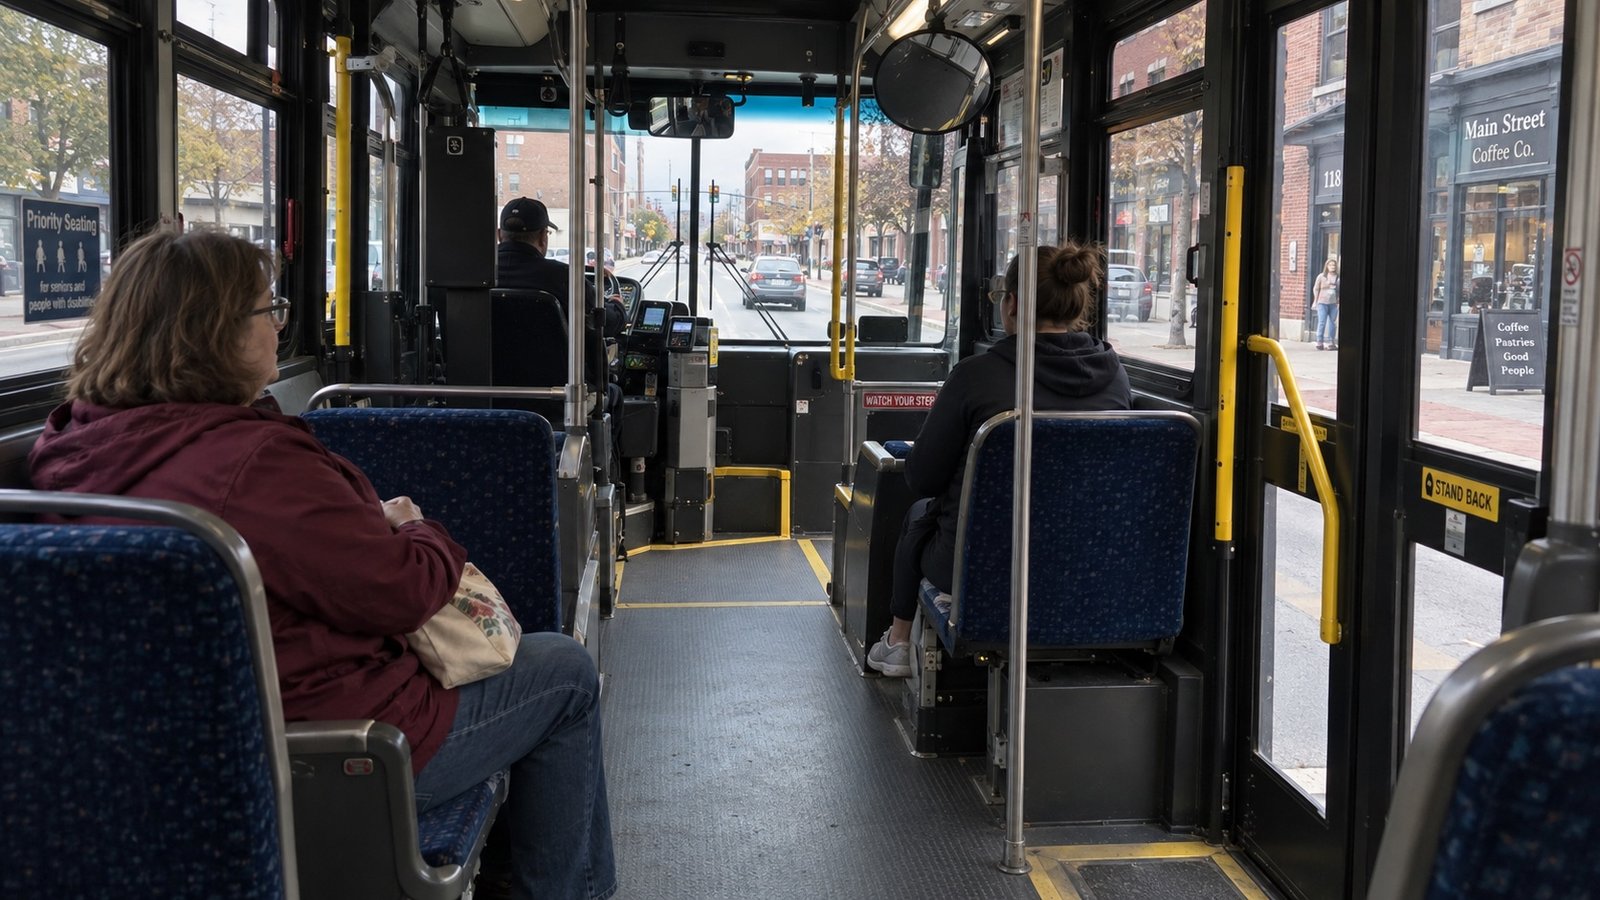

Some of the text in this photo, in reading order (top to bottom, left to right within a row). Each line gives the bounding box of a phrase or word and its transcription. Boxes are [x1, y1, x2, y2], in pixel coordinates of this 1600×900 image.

[1464, 109, 1546, 140] Main Street
[1472, 140, 1534, 164] Coffee Co.
[1324, 169, 1341, 188] 118
[27, 209, 97, 236] Priority Seating
[40, 280, 85, 293] for seniors and
[29, 297, 51, 314] people
[52, 296, 66, 309] with
[1497, 322, 1529, 332] Coffee
[1495, 337, 1535, 347] Pastries
[1503, 351, 1529, 361] Good
[1501, 365, 1535, 377] People
[866, 395, 935, 406] WATCH YOUR STEP
[1435, 479, 1492, 512] STAND BACK
